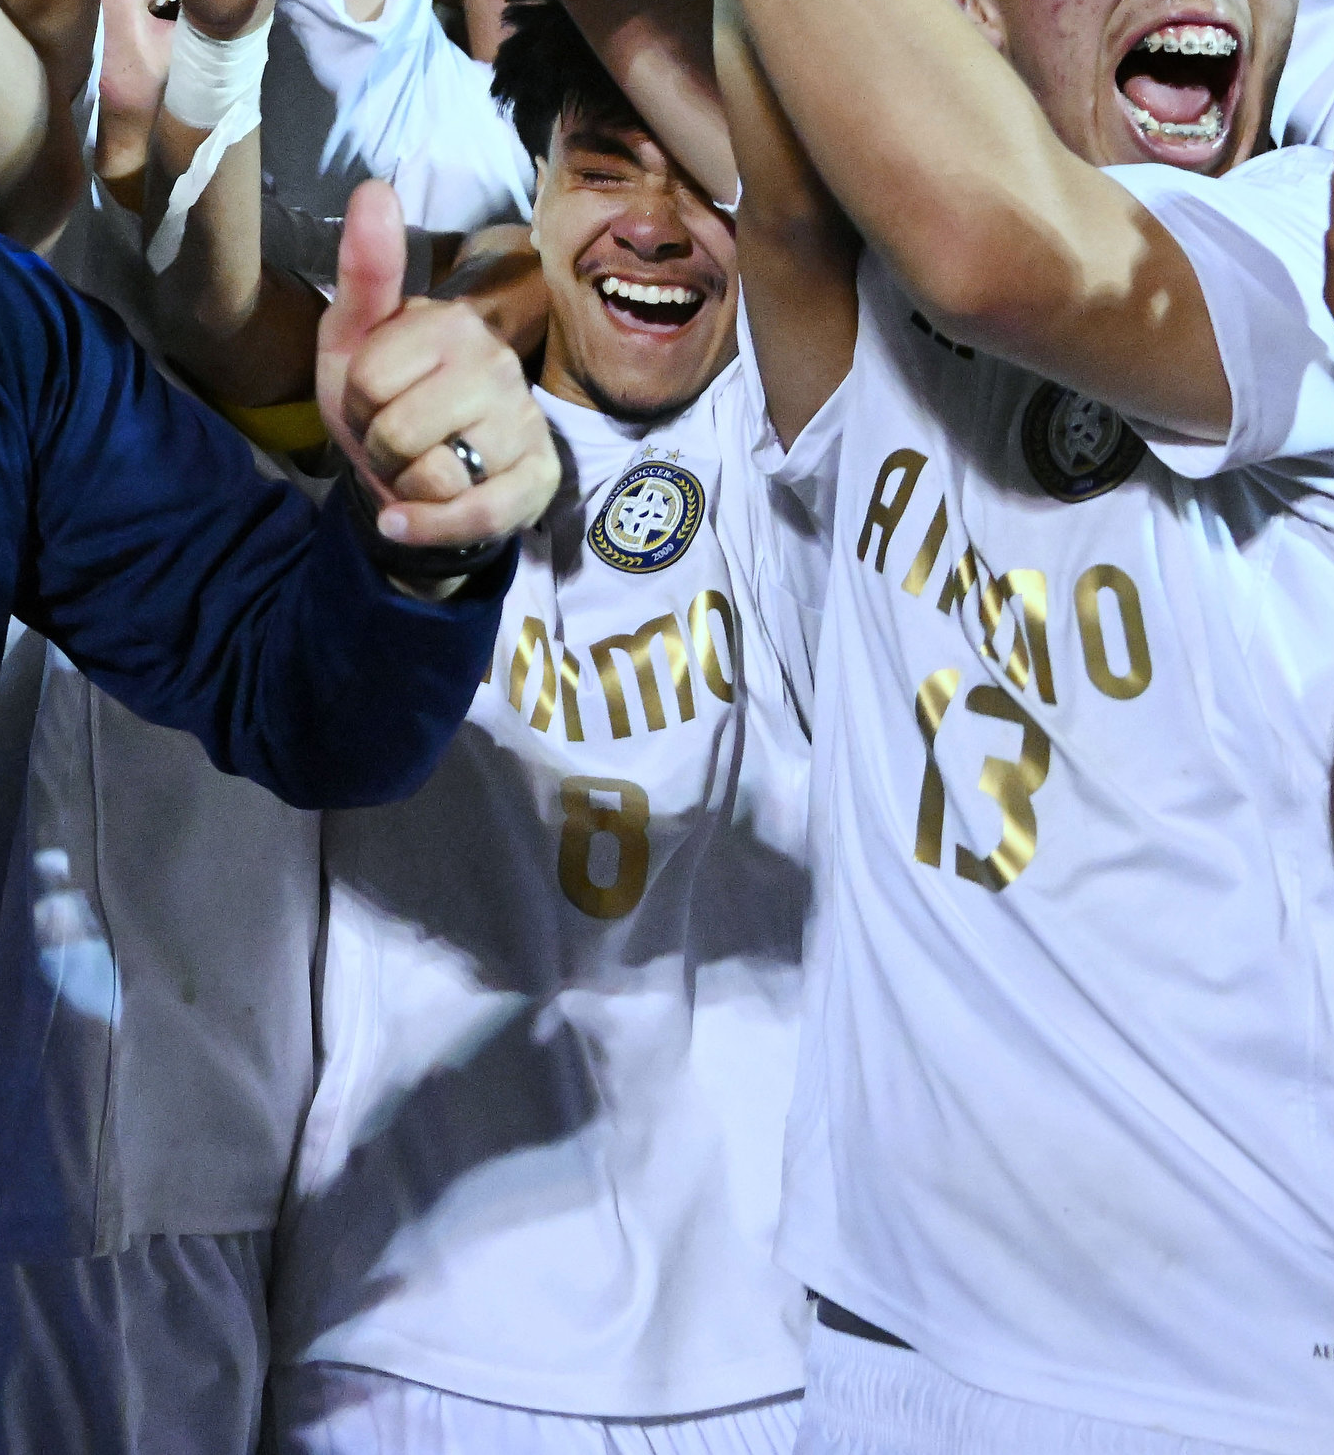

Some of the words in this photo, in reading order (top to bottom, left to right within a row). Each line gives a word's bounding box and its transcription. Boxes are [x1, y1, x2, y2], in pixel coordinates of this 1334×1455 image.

[628, 467, 673, 483] SOCCER
[651, 542, 675, 563] 2000
[480, 589, 737, 742] NIMO
[557, 774, 650, 920] 8
[913, 668, 1051, 893] 13
